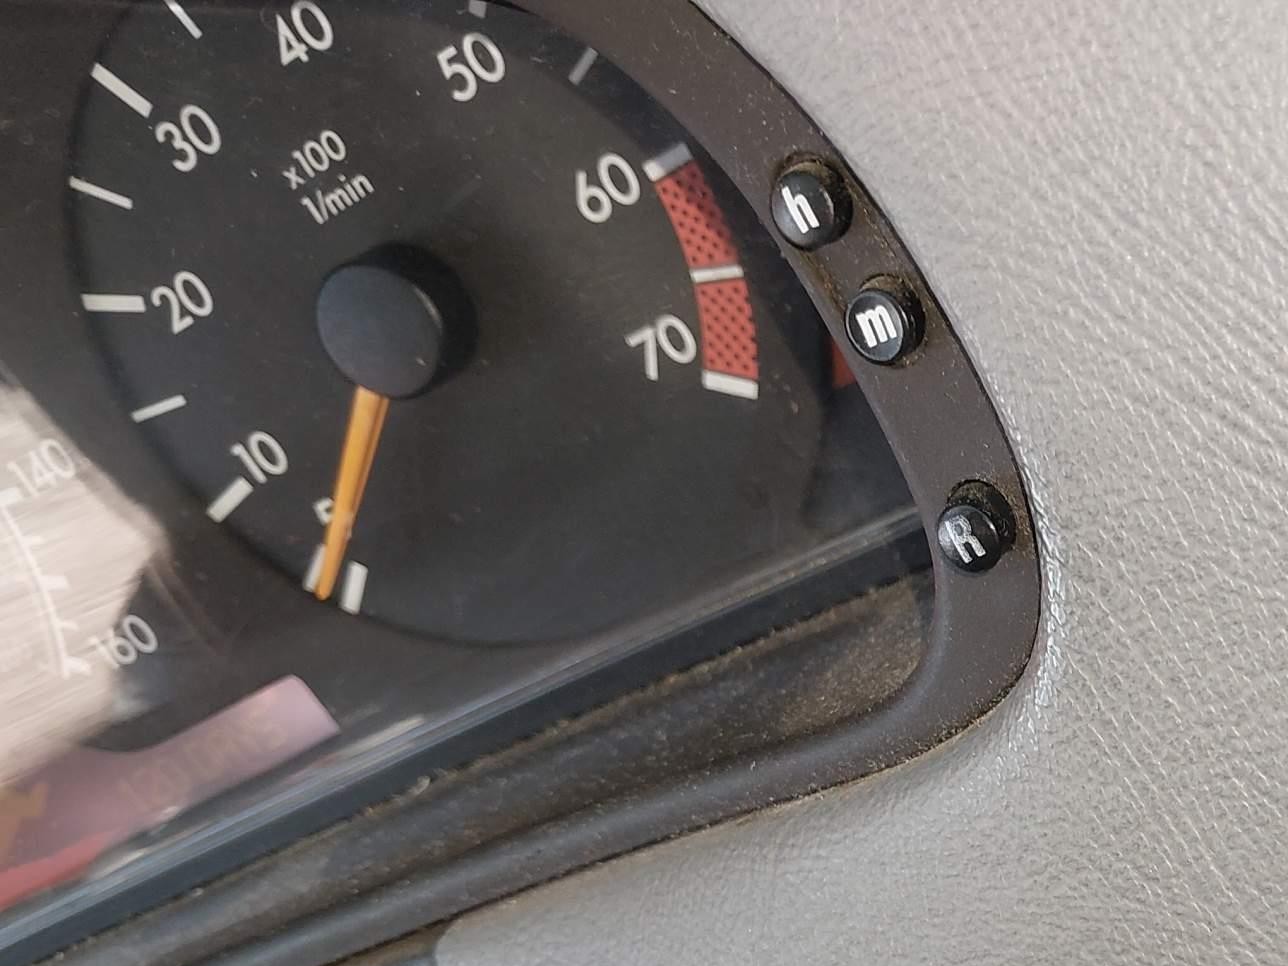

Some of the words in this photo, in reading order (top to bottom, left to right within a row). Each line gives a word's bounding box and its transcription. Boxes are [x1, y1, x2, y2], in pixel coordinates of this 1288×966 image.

[276, 1, 333, 66] 40
[437, 33, 504, 101] 50
[155, 105, 221, 172] 30
[282, 130, 347, 190] x100
[300, 173, 375, 225] 1/min
[575, 153, 641, 222] 60
[781, 186, 820, 234] h
[151, 271, 213, 334] 20
[855, 304, 897, 348] m
[626, 314, 697, 380] 70
[7, 438, 76, 497] 140
[231, 431, 288, 484] 10
[944, 514, 987, 564] R
[88, 615, 158, 669] 160
